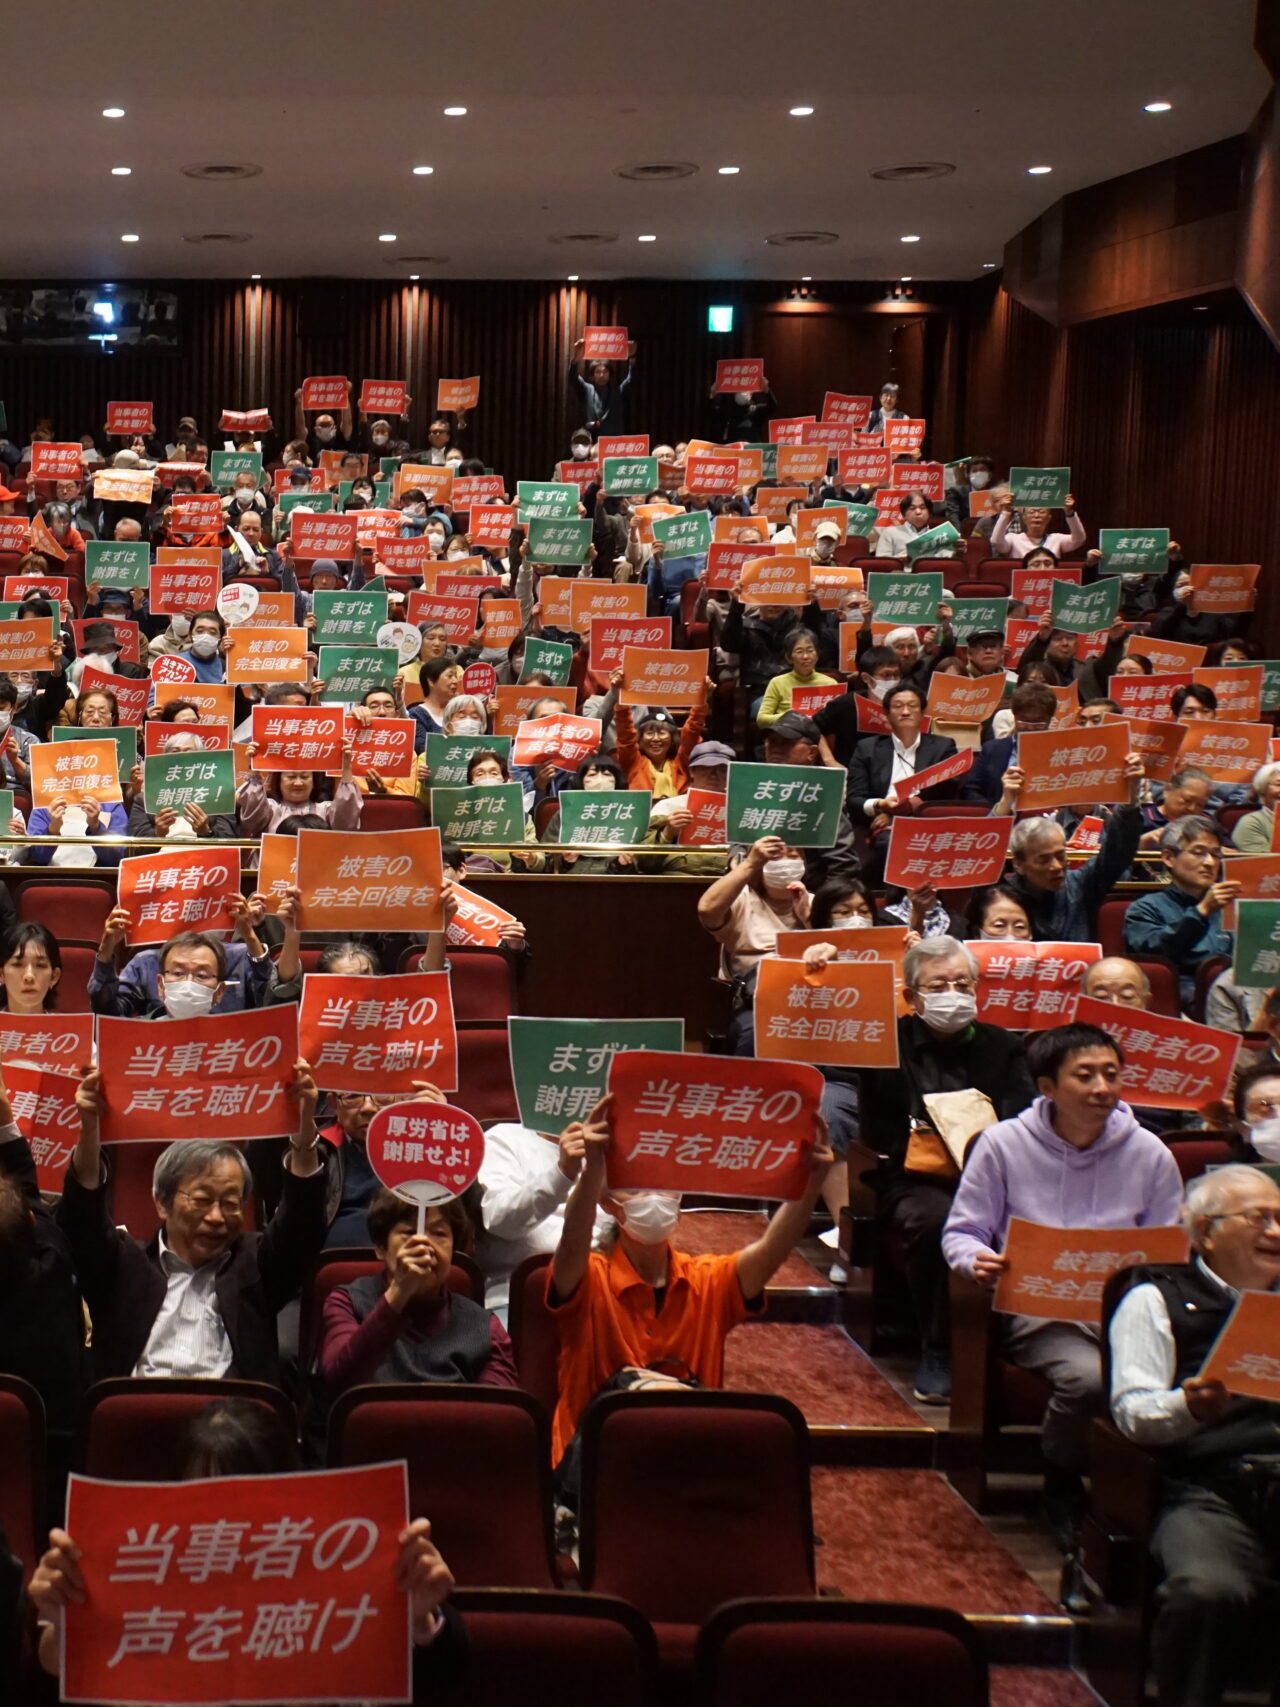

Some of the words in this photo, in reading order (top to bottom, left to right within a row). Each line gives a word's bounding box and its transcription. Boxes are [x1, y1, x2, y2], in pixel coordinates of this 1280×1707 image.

[526, 505, 570, 517] 謝罪を！
[301, 522, 352, 535] 当事者の
[543, 528, 581, 540] まずは
[668, 521, 698, 536] まずは
[299, 539, 350, 551] 声を聴け
[534, 543, 582, 555] 謝罪を！
[1117, 537, 1156, 549] まずは
[100, 551, 137, 563] まずは
[92, 567, 139, 579] 謝罪を！
[160, 575, 212, 587] 当事者の
[745, 582, 805, 594] 完全回復を
[886, 583, 930, 596] まずは
[159, 592, 211, 604] 声を聴け
[1066, 591, 1106, 608] まずは
[330, 601, 374, 615] まずは
[417, 604, 471, 619] 当事者の
[873, 601, 932, 618] 謝罪を！
[955, 608, 995, 620] まずは
[1056, 606, 1110, 624] 謝罪を！
[321, 620, 376, 634] 謝罪を！
[602, 628, 663, 643] 当事者の
[249, 640, 288, 653] 被害の
[235, 658, 302, 670] 完全回復を
[337, 658, 384, 672] まずは
[537, 651, 564, 665] まずは
[645, 663, 688, 675] 被害の
[629, 680, 701, 693] 完全回復を
[265, 719, 335, 736] 当事者の
[527, 724, 593, 742] 当事者の
[263, 742, 335, 758] 声を聴け
[1200, 735, 1248, 749] 被害の
[56, 755, 98, 771] 被害の
[1050, 746, 1106, 766] 被害の
[1181, 752, 1263, 772] 完全回復を
[166, 763, 217, 781] まずは
[1026, 768, 1121, 792] 完全回復を
[42, 774, 113, 792] 完全回復を
[754, 781, 822, 802] まずは
[455, 797, 506, 815] まずは
[581, 803, 634, 820] まずは
[445, 819, 511, 837] 謝罪を！
[739, 808, 824, 831] 謝罪を！
[570, 827, 636, 845] 謝罪を！
[906, 832, 999, 852] 当事者の
[338, 856, 412, 877] 被害の
[901, 858, 994, 877] 声を聴け
[134, 866, 228, 893] 当事者の
[309, 886, 433, 907] 完全回復を
[987, 953, 1088, 980] 当事者の
[788, 985, 859, 1008] 被害の
[318, 997, 437, 1029] 当事者の
[766, 1016, 885, 1042] 完全回復を
[125, 1036, 281, 1077] 当事者の
[315, 1038, 444, 1070] 声を聴け
[1120, 1060, 1213, 1097] を聴け
[124, 1084, 283, 1116] 声を聴け
[635, 1081, 801, 1123] 当事者の
[387, 1116, 470, 1142] 厚労省は
[627, 1131, 796, 1170] 声を聴け
[110, 1517, 378, 1582] 当事者の
[108, 1598, 377, 1664] 声を聴け
